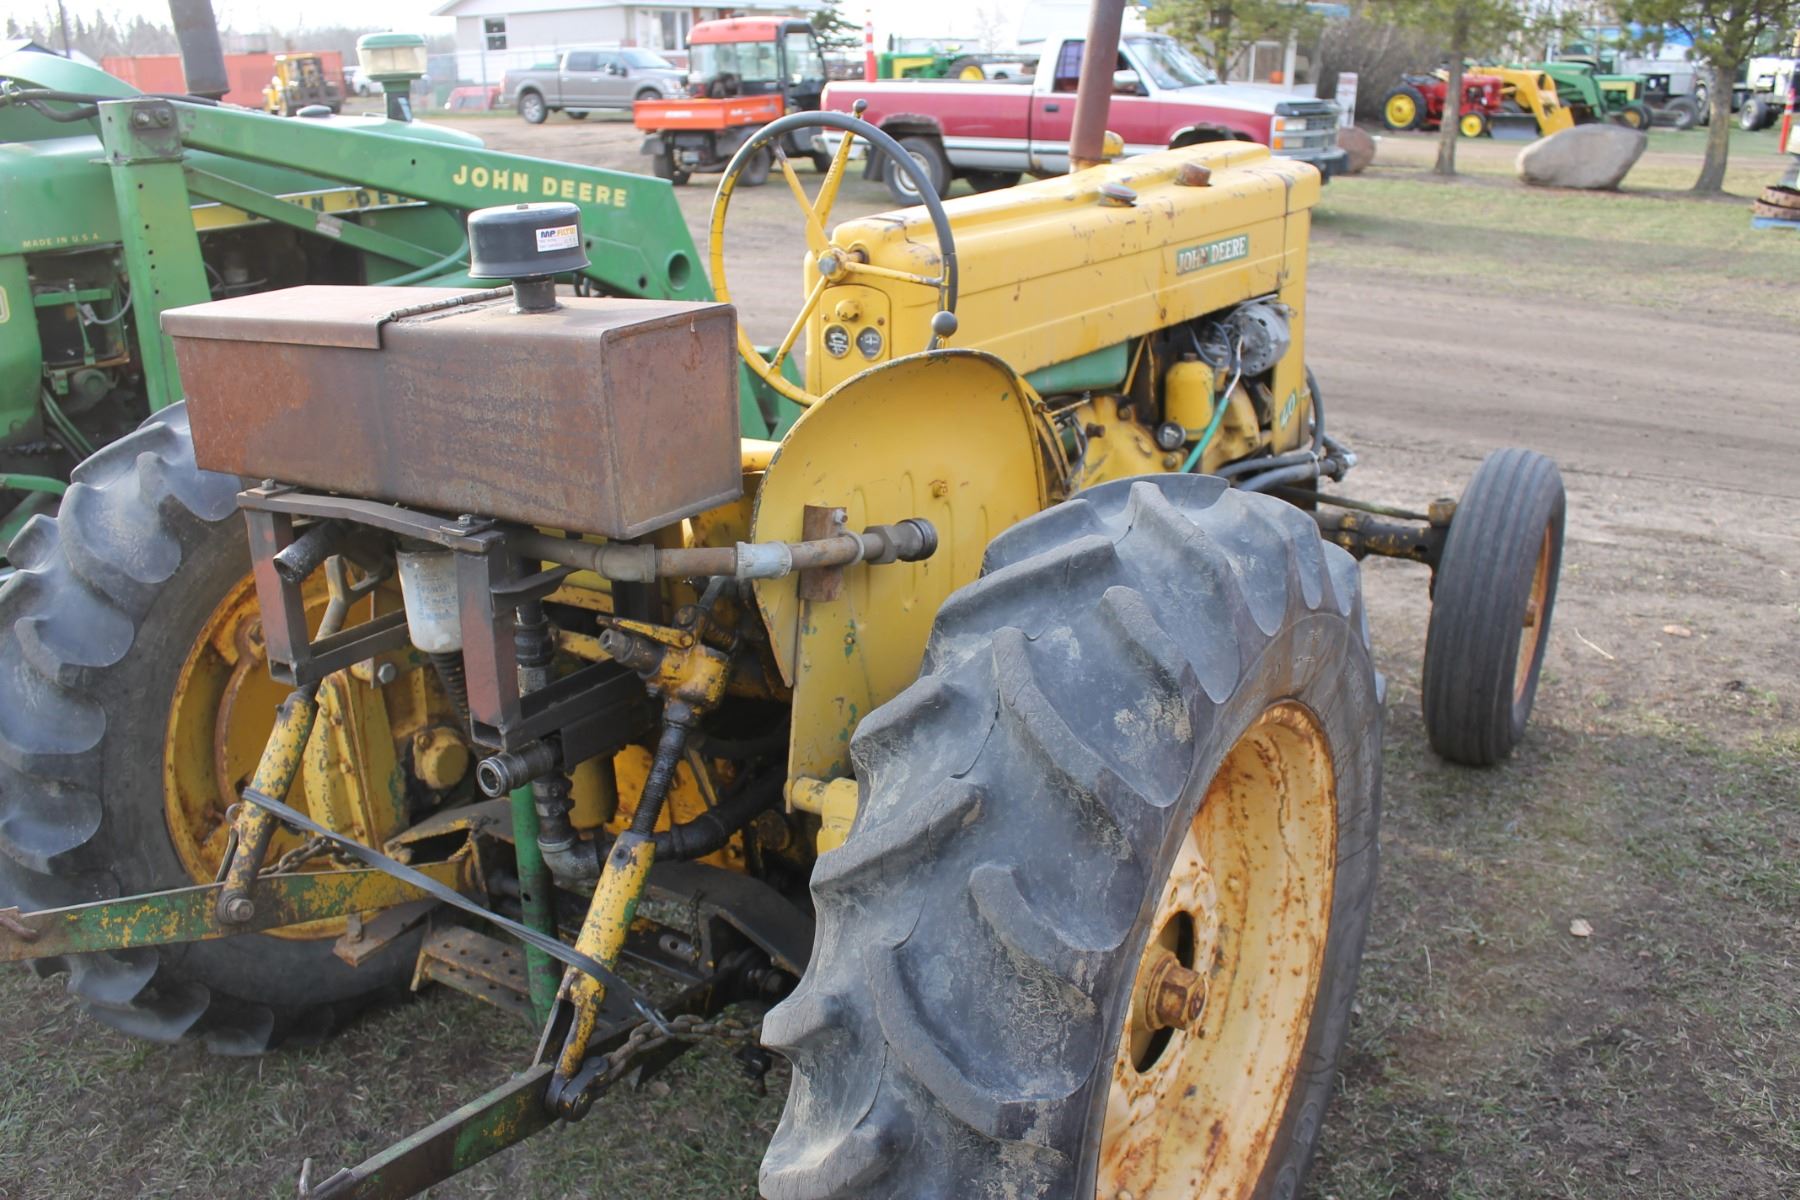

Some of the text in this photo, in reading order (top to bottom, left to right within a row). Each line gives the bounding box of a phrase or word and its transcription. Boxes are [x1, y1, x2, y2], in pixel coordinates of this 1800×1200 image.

[453, 165, 627, 207] JOHN DEERE
[23, 238, 52, 248] MADE
[56, 236, 68, 244] IN
[1211, 237, 1246, 263] DEERE
